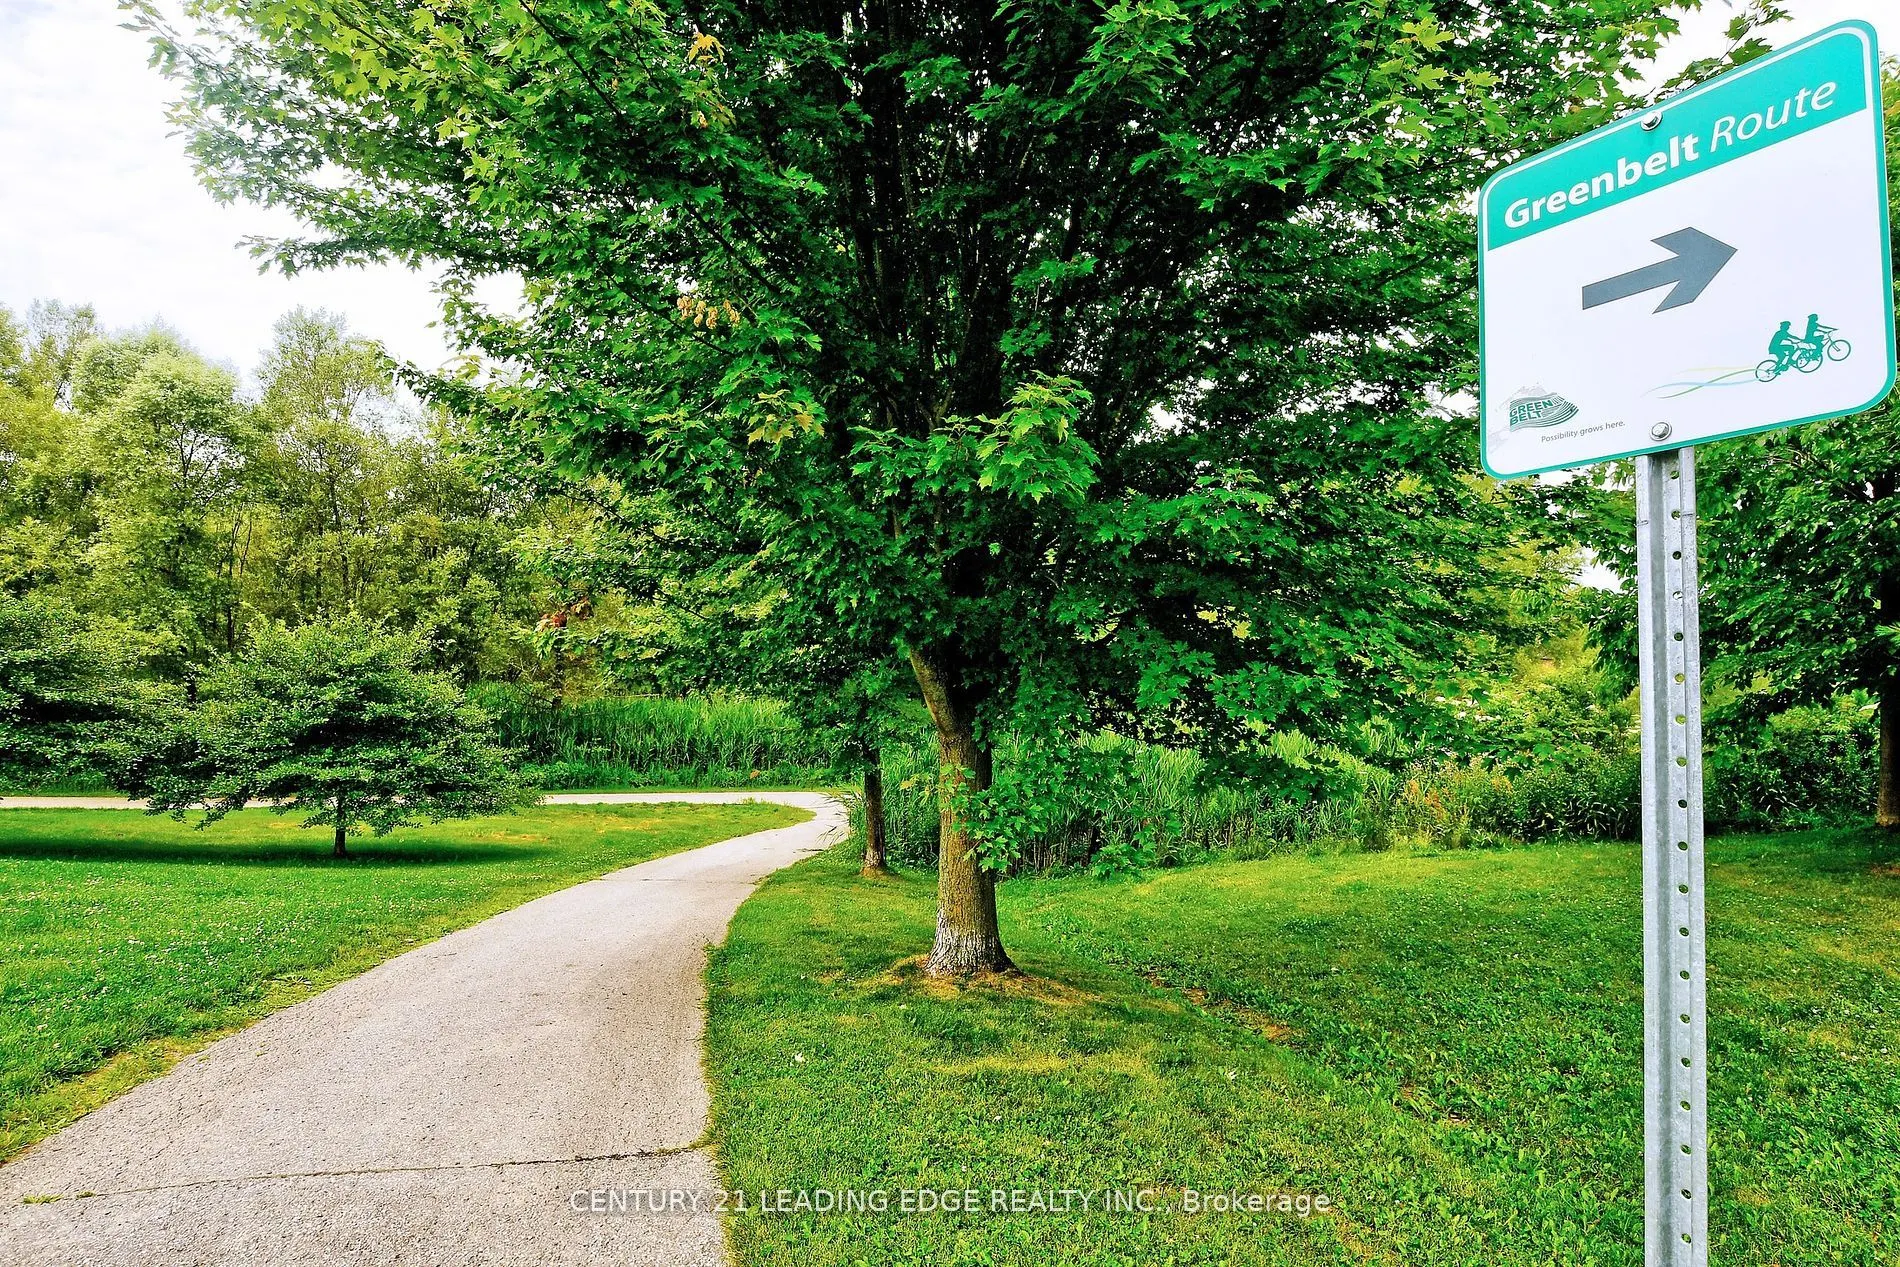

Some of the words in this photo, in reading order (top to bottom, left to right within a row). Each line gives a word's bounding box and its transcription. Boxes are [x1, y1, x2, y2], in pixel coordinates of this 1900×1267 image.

[1504, 134, 1699, 229] Greenbelt
[1710, 81, 1837, 153] Route
[1509, 400, 1554, 418] GREEN
[1509, 411, 1542, 426] BELT
[1541, 430, 1578, 443] Possibility
[1580, 424, 1604, 436] grows
[1605, 420, 1626, 430] here.
